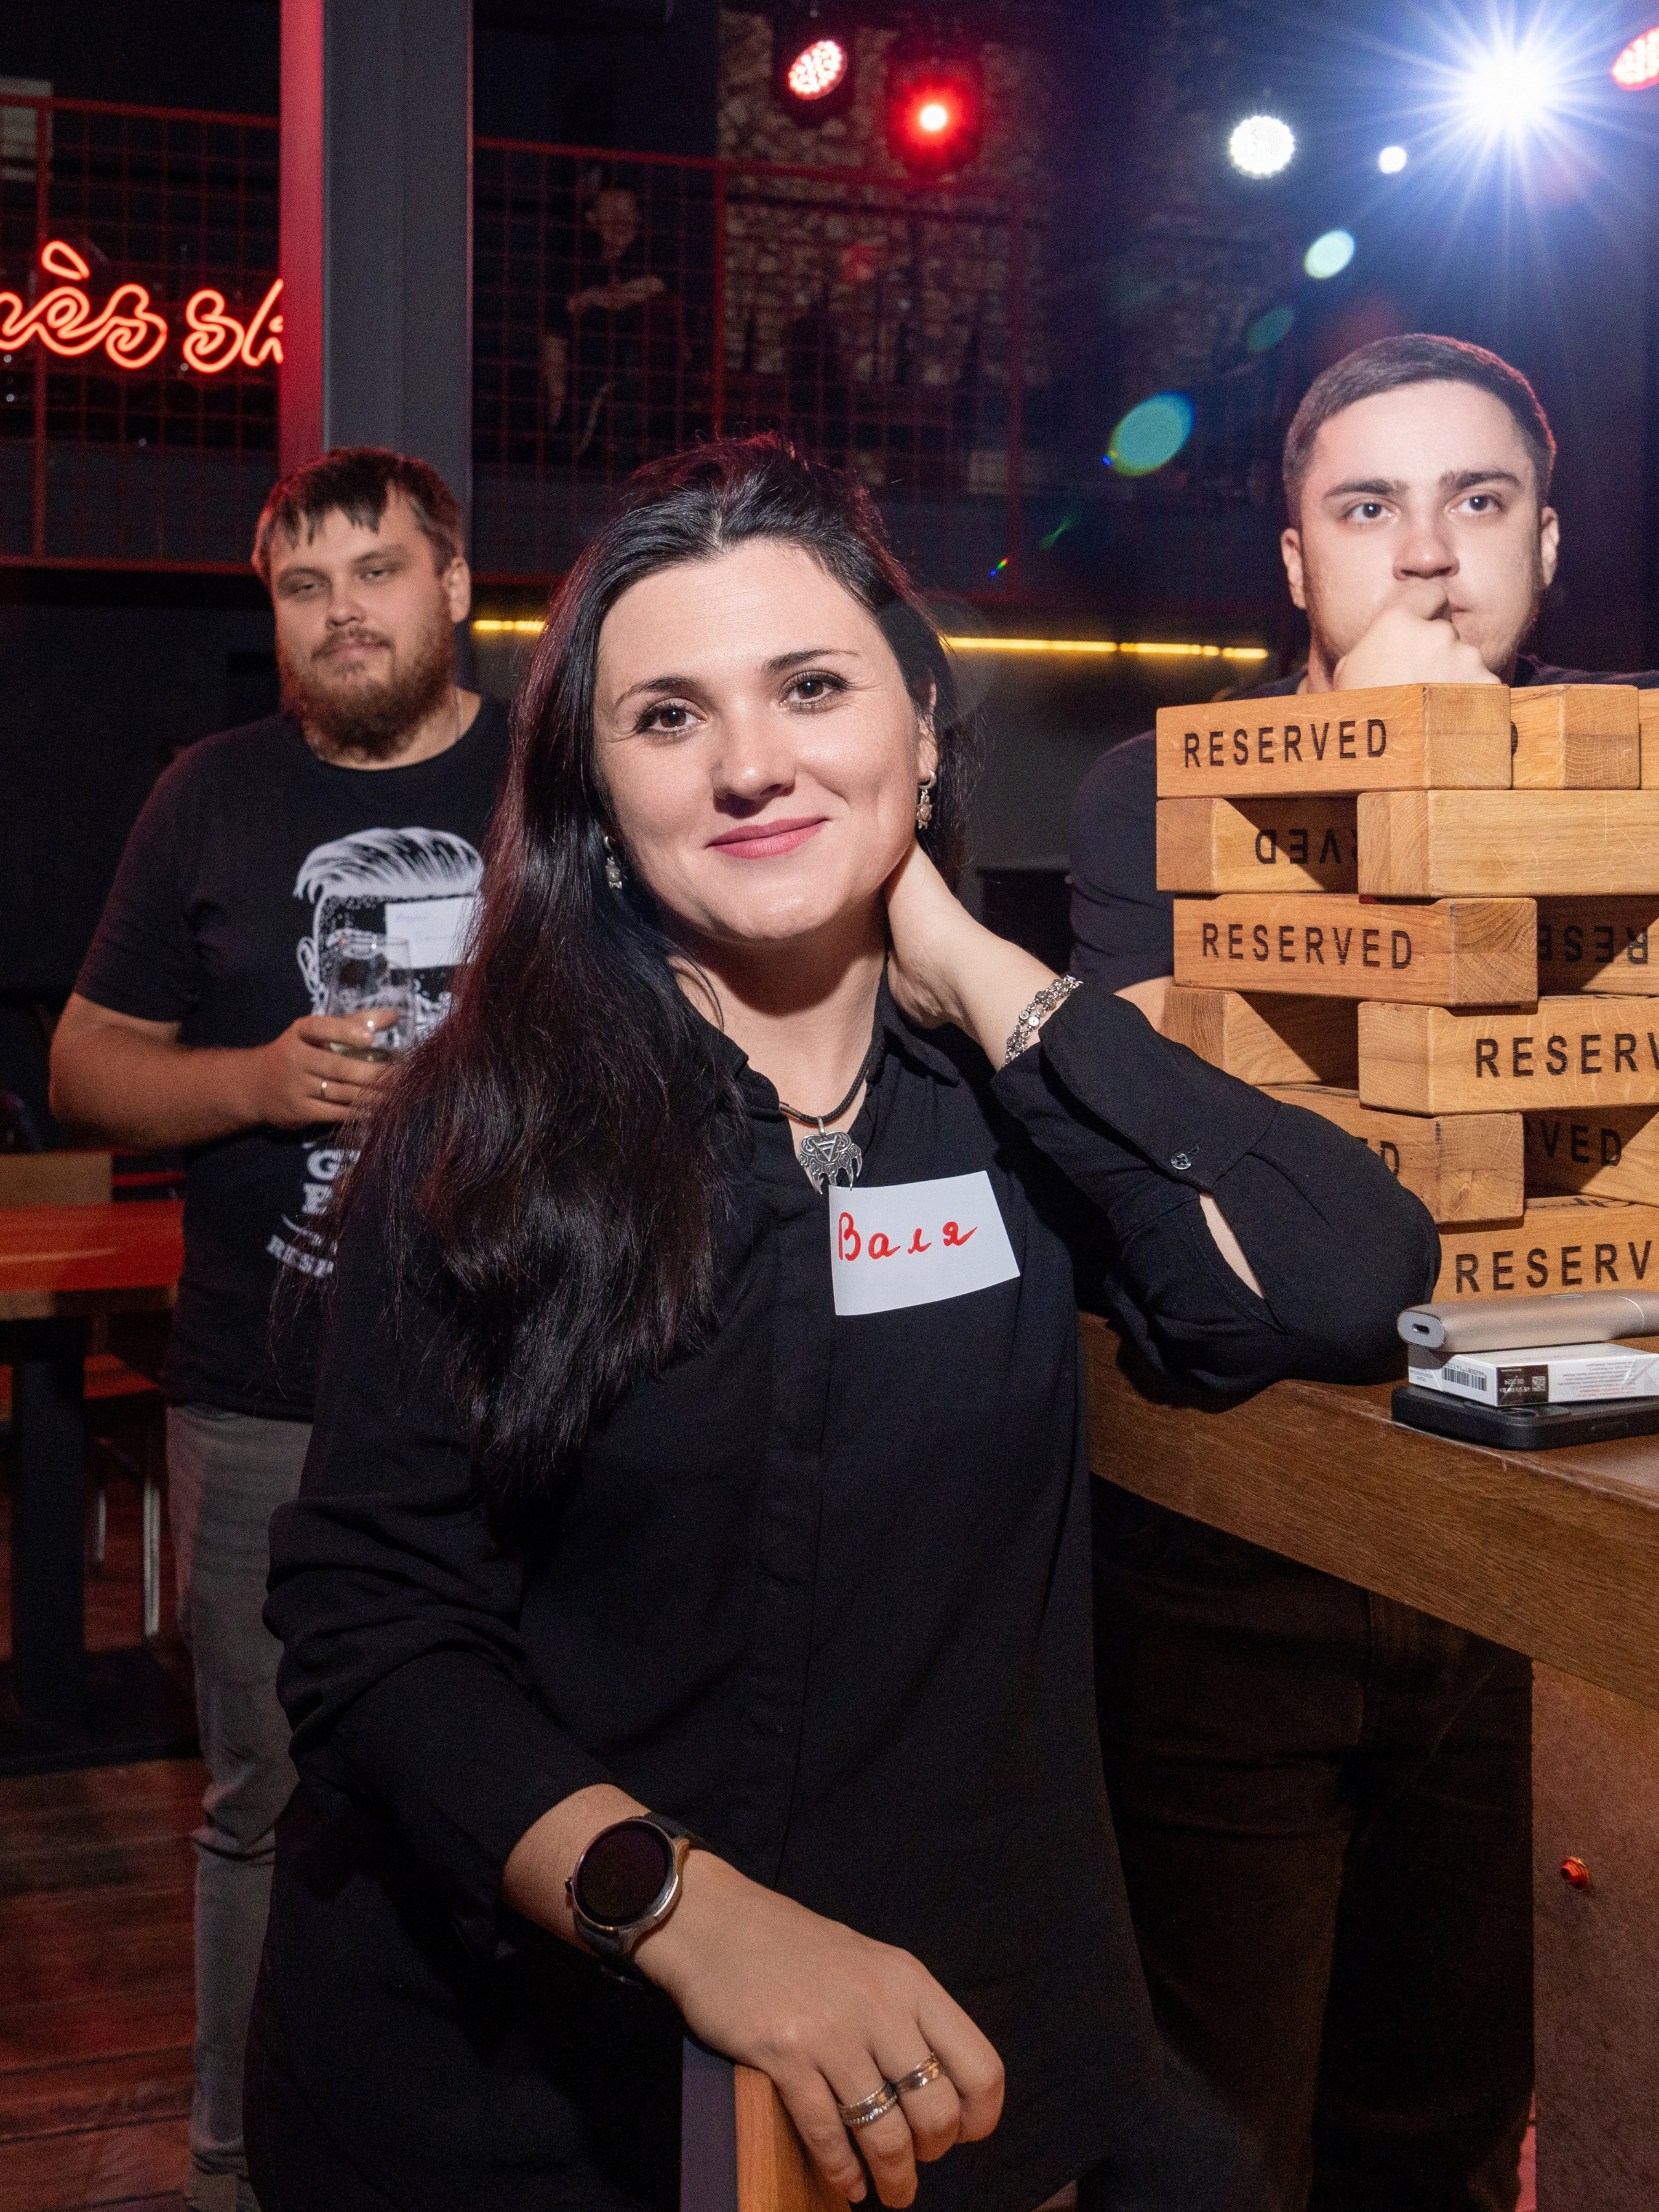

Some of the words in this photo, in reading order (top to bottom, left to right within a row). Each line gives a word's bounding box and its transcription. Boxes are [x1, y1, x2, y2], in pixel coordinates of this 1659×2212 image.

[1183, 718, 1387, 768] RESERVED
[1255, 829, 1358, 865] VED
[1201, 922, 1413, 970] RESERVED
[838, 1211, 979, 1261] Валя
[1456, 1240, 1653, 1294] RESERV
